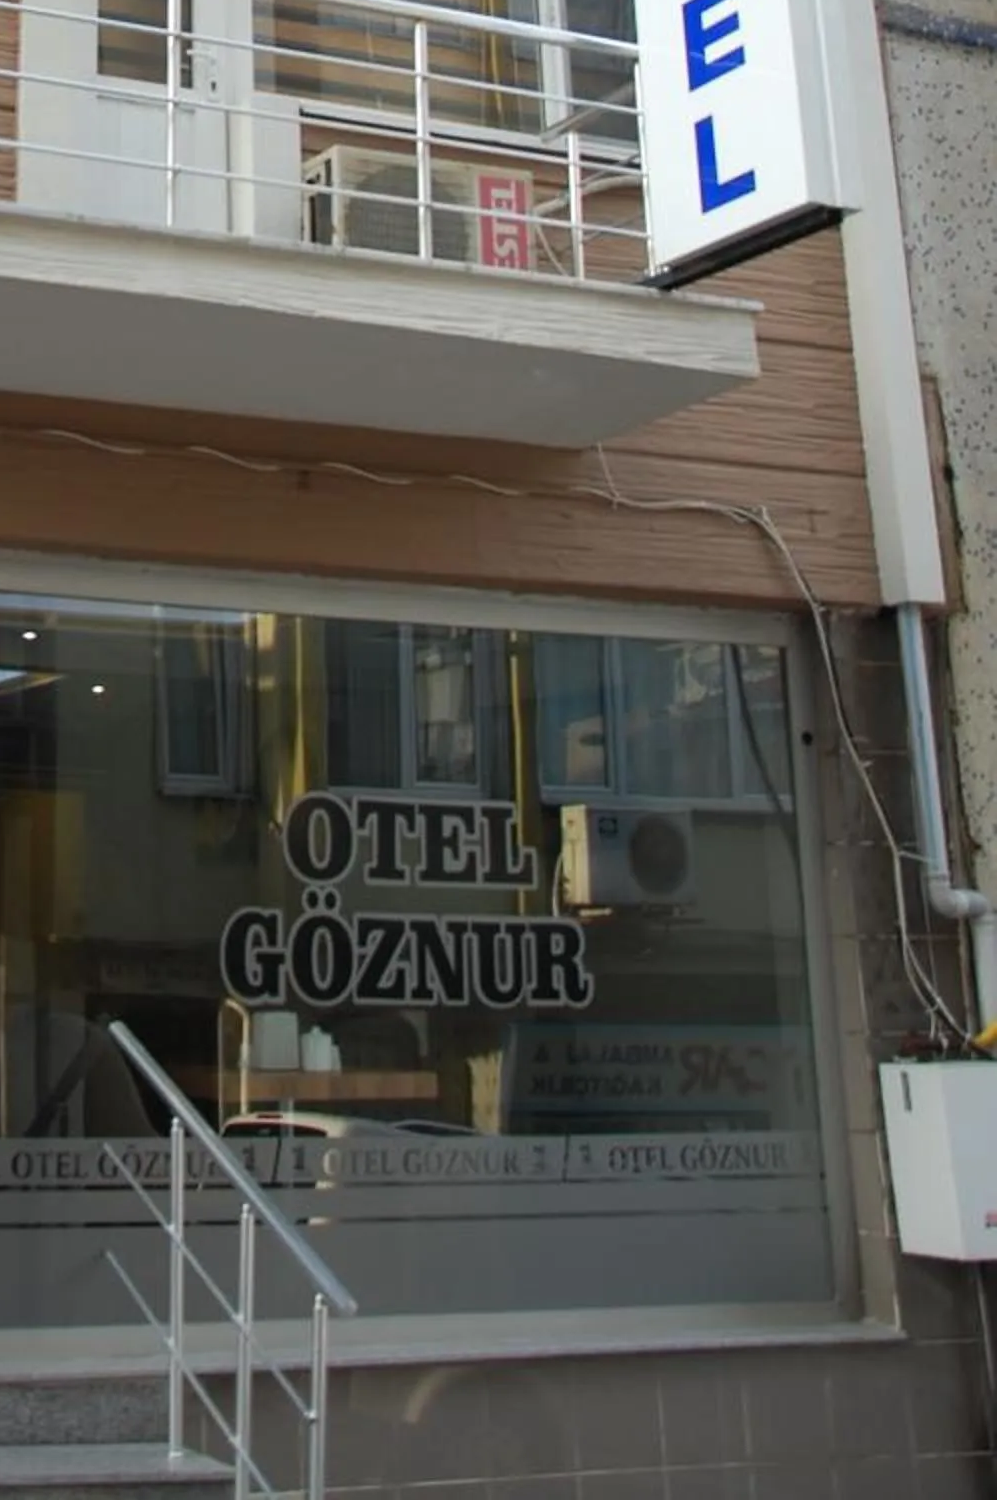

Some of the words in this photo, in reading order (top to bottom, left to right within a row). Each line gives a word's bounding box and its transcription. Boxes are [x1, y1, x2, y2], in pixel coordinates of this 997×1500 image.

[491, 180, 521, 269] ESTEL
[283, 791, 538, 889] OTEL
[221, 887, 594, 1007] GÖZNUR
[11, 1150, 88, 1179] OTEL
[322, 1147, 396, 1175] OTEL
[403, 1141, 522, 1176] GÖZNUR
[608, 1145, 674, 1173] OTEL
[680, 1138, 788, 1171] GÖZNUR
